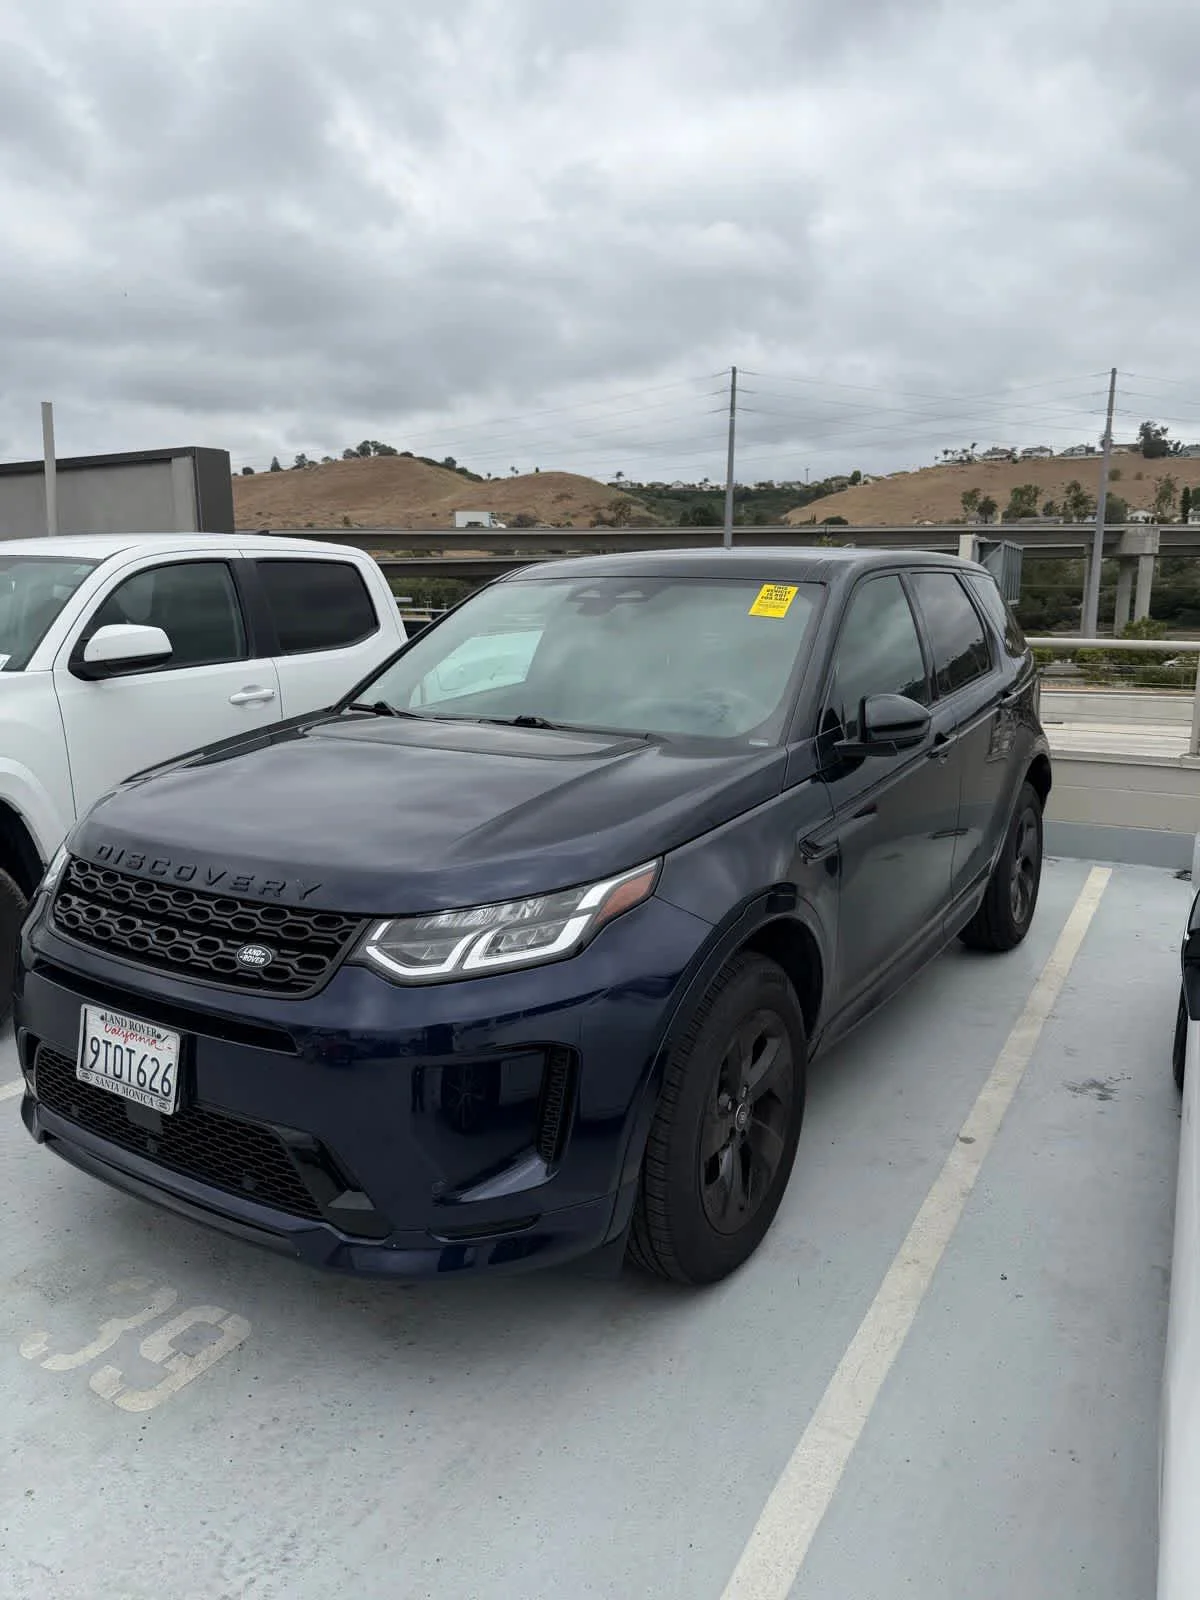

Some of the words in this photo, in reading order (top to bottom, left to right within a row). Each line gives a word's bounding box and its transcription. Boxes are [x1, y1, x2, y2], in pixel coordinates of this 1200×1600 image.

[97, 843, 323, 900] DISCOVERY
[242, 954, 265, 964] ROVER
[243, 947, 262, 956] LAND
[104, 1012, 127, 1028] LAND
[129, 1019, 157, 1038] ROVER
[95, 1075, 119, 1093] SANTA
[122, 1086, 154, 1107] MONICA
